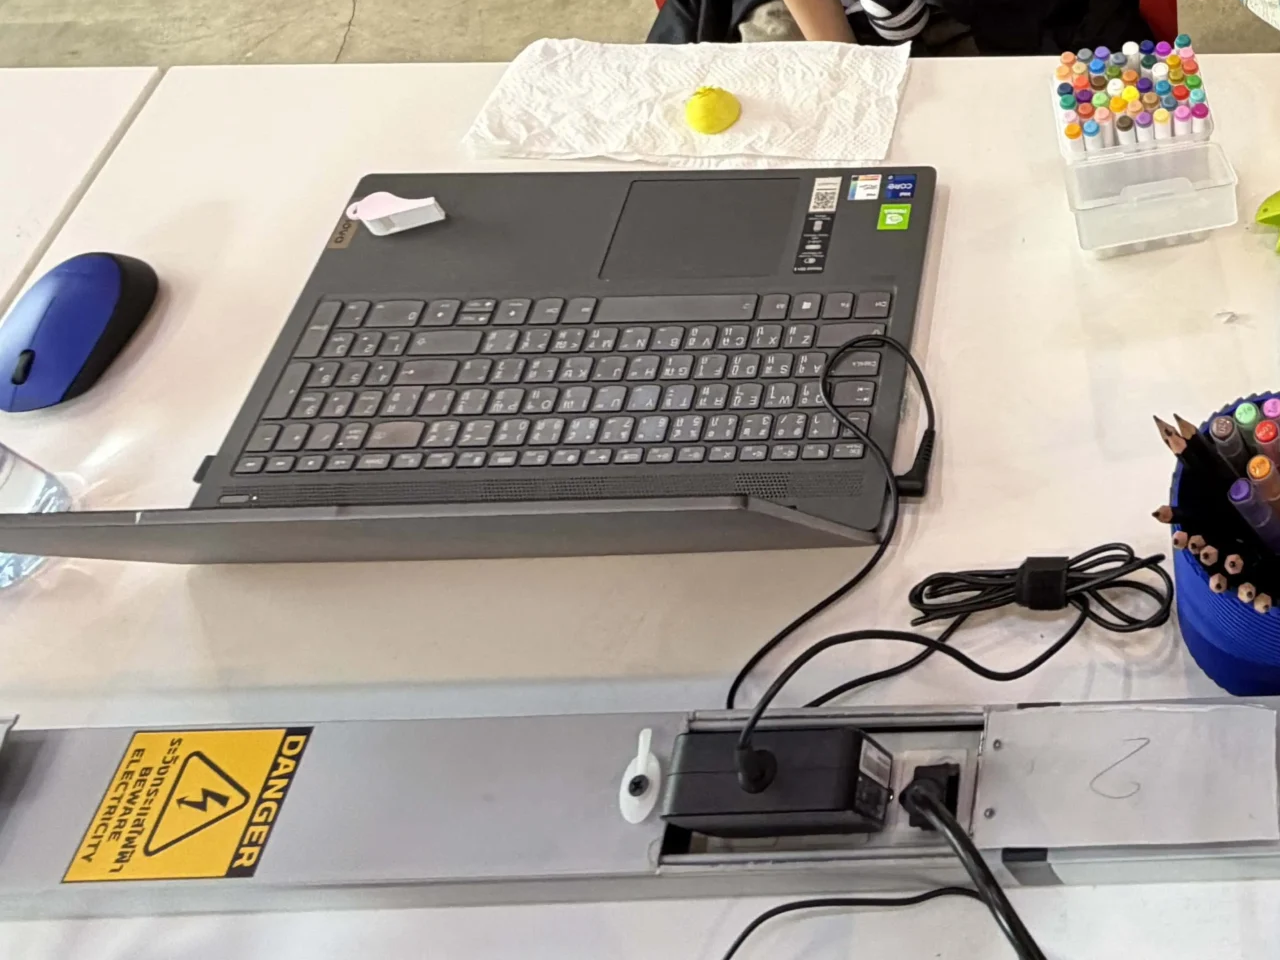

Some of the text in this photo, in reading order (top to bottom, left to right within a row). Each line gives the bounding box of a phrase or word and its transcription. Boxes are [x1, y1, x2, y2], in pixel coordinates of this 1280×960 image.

[81, 748, 145, 863] ELECTRICITY
[110, 767, 153, 842] BEWARE
[233, 735, 307, 868] DANGER
